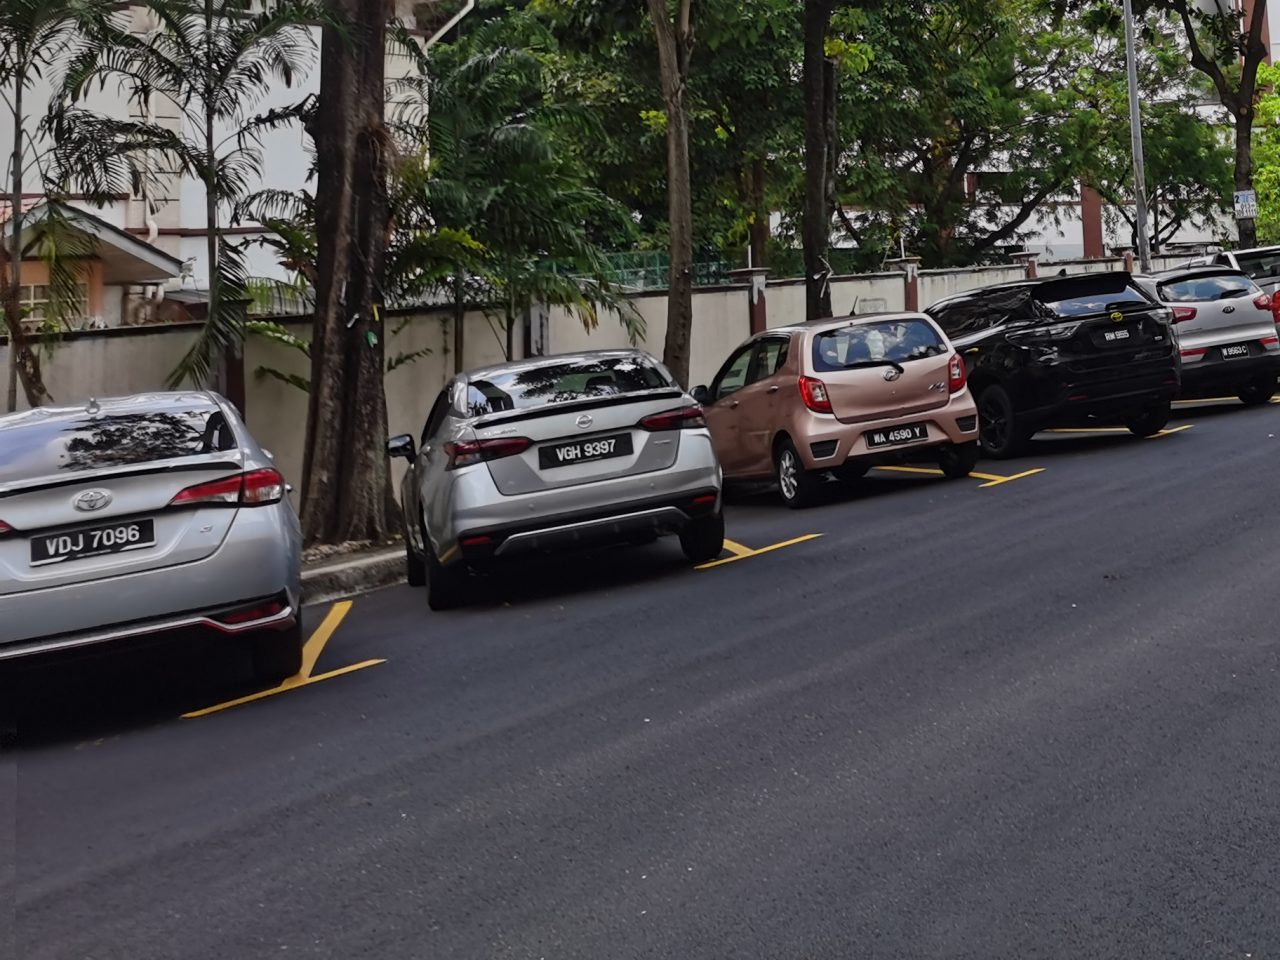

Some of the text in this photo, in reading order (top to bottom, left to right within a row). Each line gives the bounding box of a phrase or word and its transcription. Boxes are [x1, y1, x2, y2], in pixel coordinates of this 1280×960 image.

[873, 427, 920, 443] WA 4590 Y
[556, 439, 616, 462] VGH 9397
[45, 525, 140, 556] VDJ 7096
